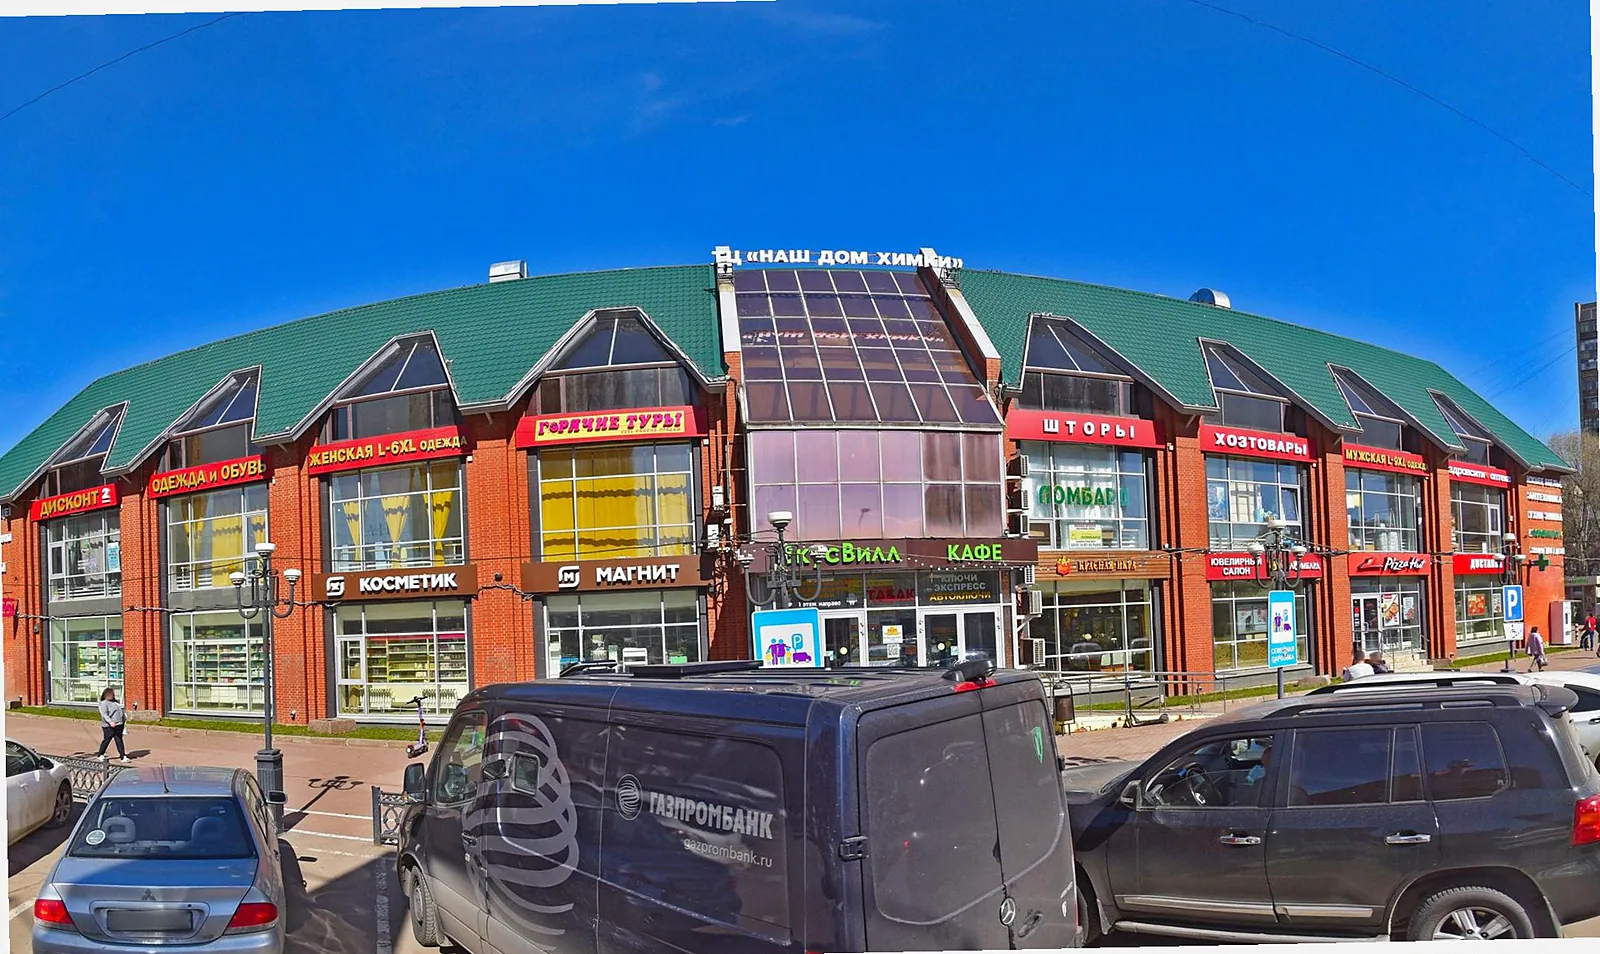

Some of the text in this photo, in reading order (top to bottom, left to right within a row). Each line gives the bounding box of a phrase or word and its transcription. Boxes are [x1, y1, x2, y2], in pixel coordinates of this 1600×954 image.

[711, 249, 963, 269] ТЦ «НАШ ДОМ ХИМКИ»
[538, 412, 683, 436] ГОРЯЧИЕ ТУРЫ
[1043, 418, 1136, 439] ШТОРЫ
[309, 435, 468, 467] ЖЕНСКАЯ L-6XL ОДЕЖДА
[1215, 432, 1307, 456] ХОЗТОВАРЫ
[1345, 449, 1386, 464] МУЖСКАЯ
[152, 469, 206, 494] ОДЕЖДА
[221, 459, 267, 481] ОБУВЬ
[40, 487, 111, 517] ДИСКОНТ 2
[783, 542, 901, 568] ксВилл
[947, 543, 1003, 561] КАФЕ
[596, 564, 680, 583] МАГНИТ
[1223, 566, 1251, 576] САЛОН
[1384, 557, 1426, 571] Pizza Hut
[359, 572, 458, 593] КОСМЕТИК
[934, 582, 986, 592] ЭКСПРЕСС
[942, 573, 978, 584] КЛЮЧИ
[929, 591, 992, 601] АВТОКЛЮЧИ
[1507, 589, 1518, 617] P
[650, 792, 773, 839] ГАЗПРОМБАНК
[683, 838, 773, 868] gazprombank.ru
